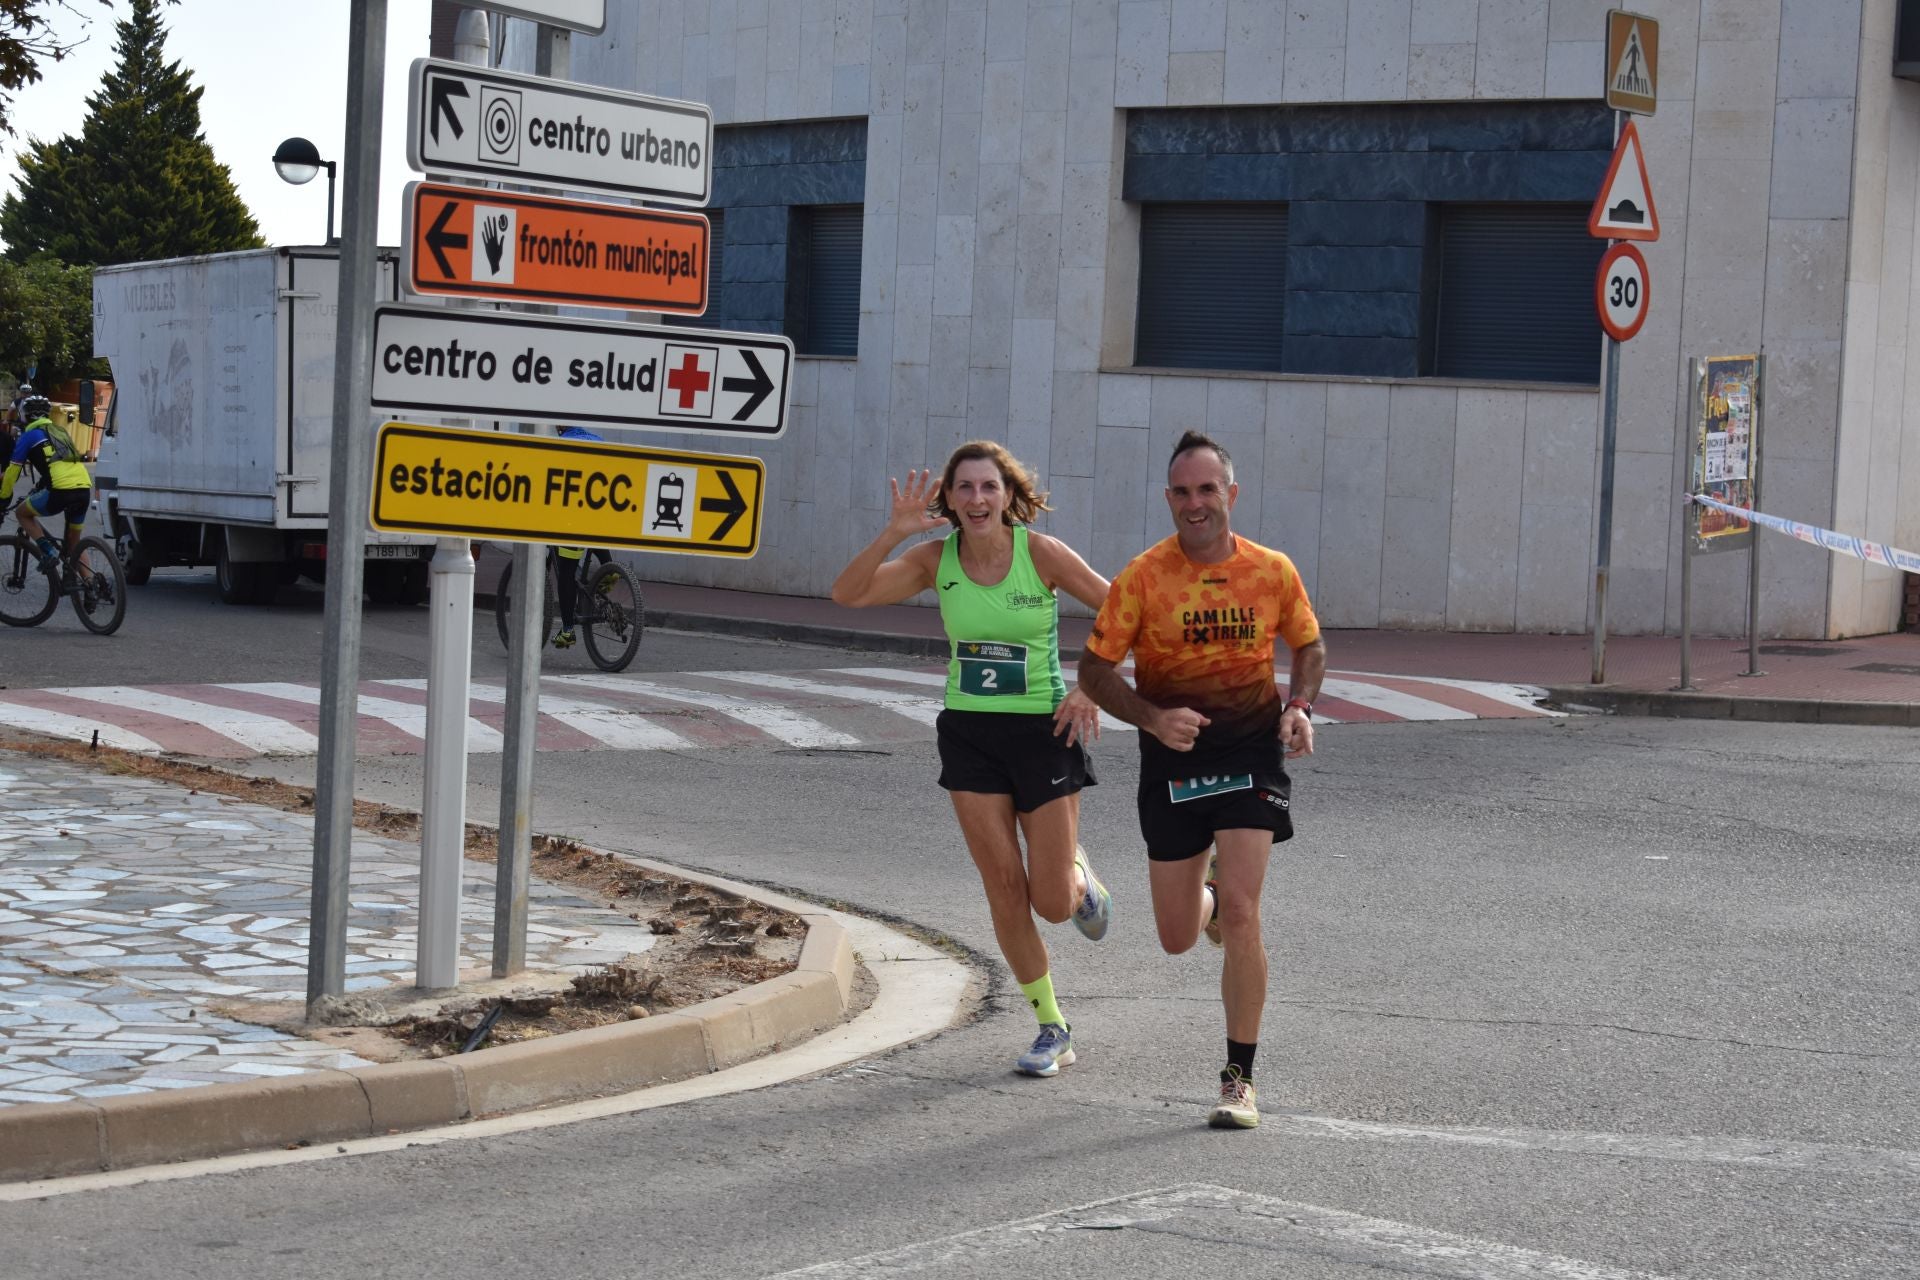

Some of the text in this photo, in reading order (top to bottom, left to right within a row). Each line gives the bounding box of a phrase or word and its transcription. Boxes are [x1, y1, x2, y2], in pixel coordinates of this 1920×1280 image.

[528, 115, 701, 170] centro urbano
[520, 224, 698, 286] frontón municipal
[123, 281, 176, 313] MUEBLES
[1609, 275, 1639, 309] 30
[383, 338, 658, 393] centro de salud
[389, 457, 638, 513] estación FF.CC.
[1183, 607, 1256, 626] CAMILLE
[1183, 624, 1256, 645] EXTREME
[981, 668, 998, 689] 2
